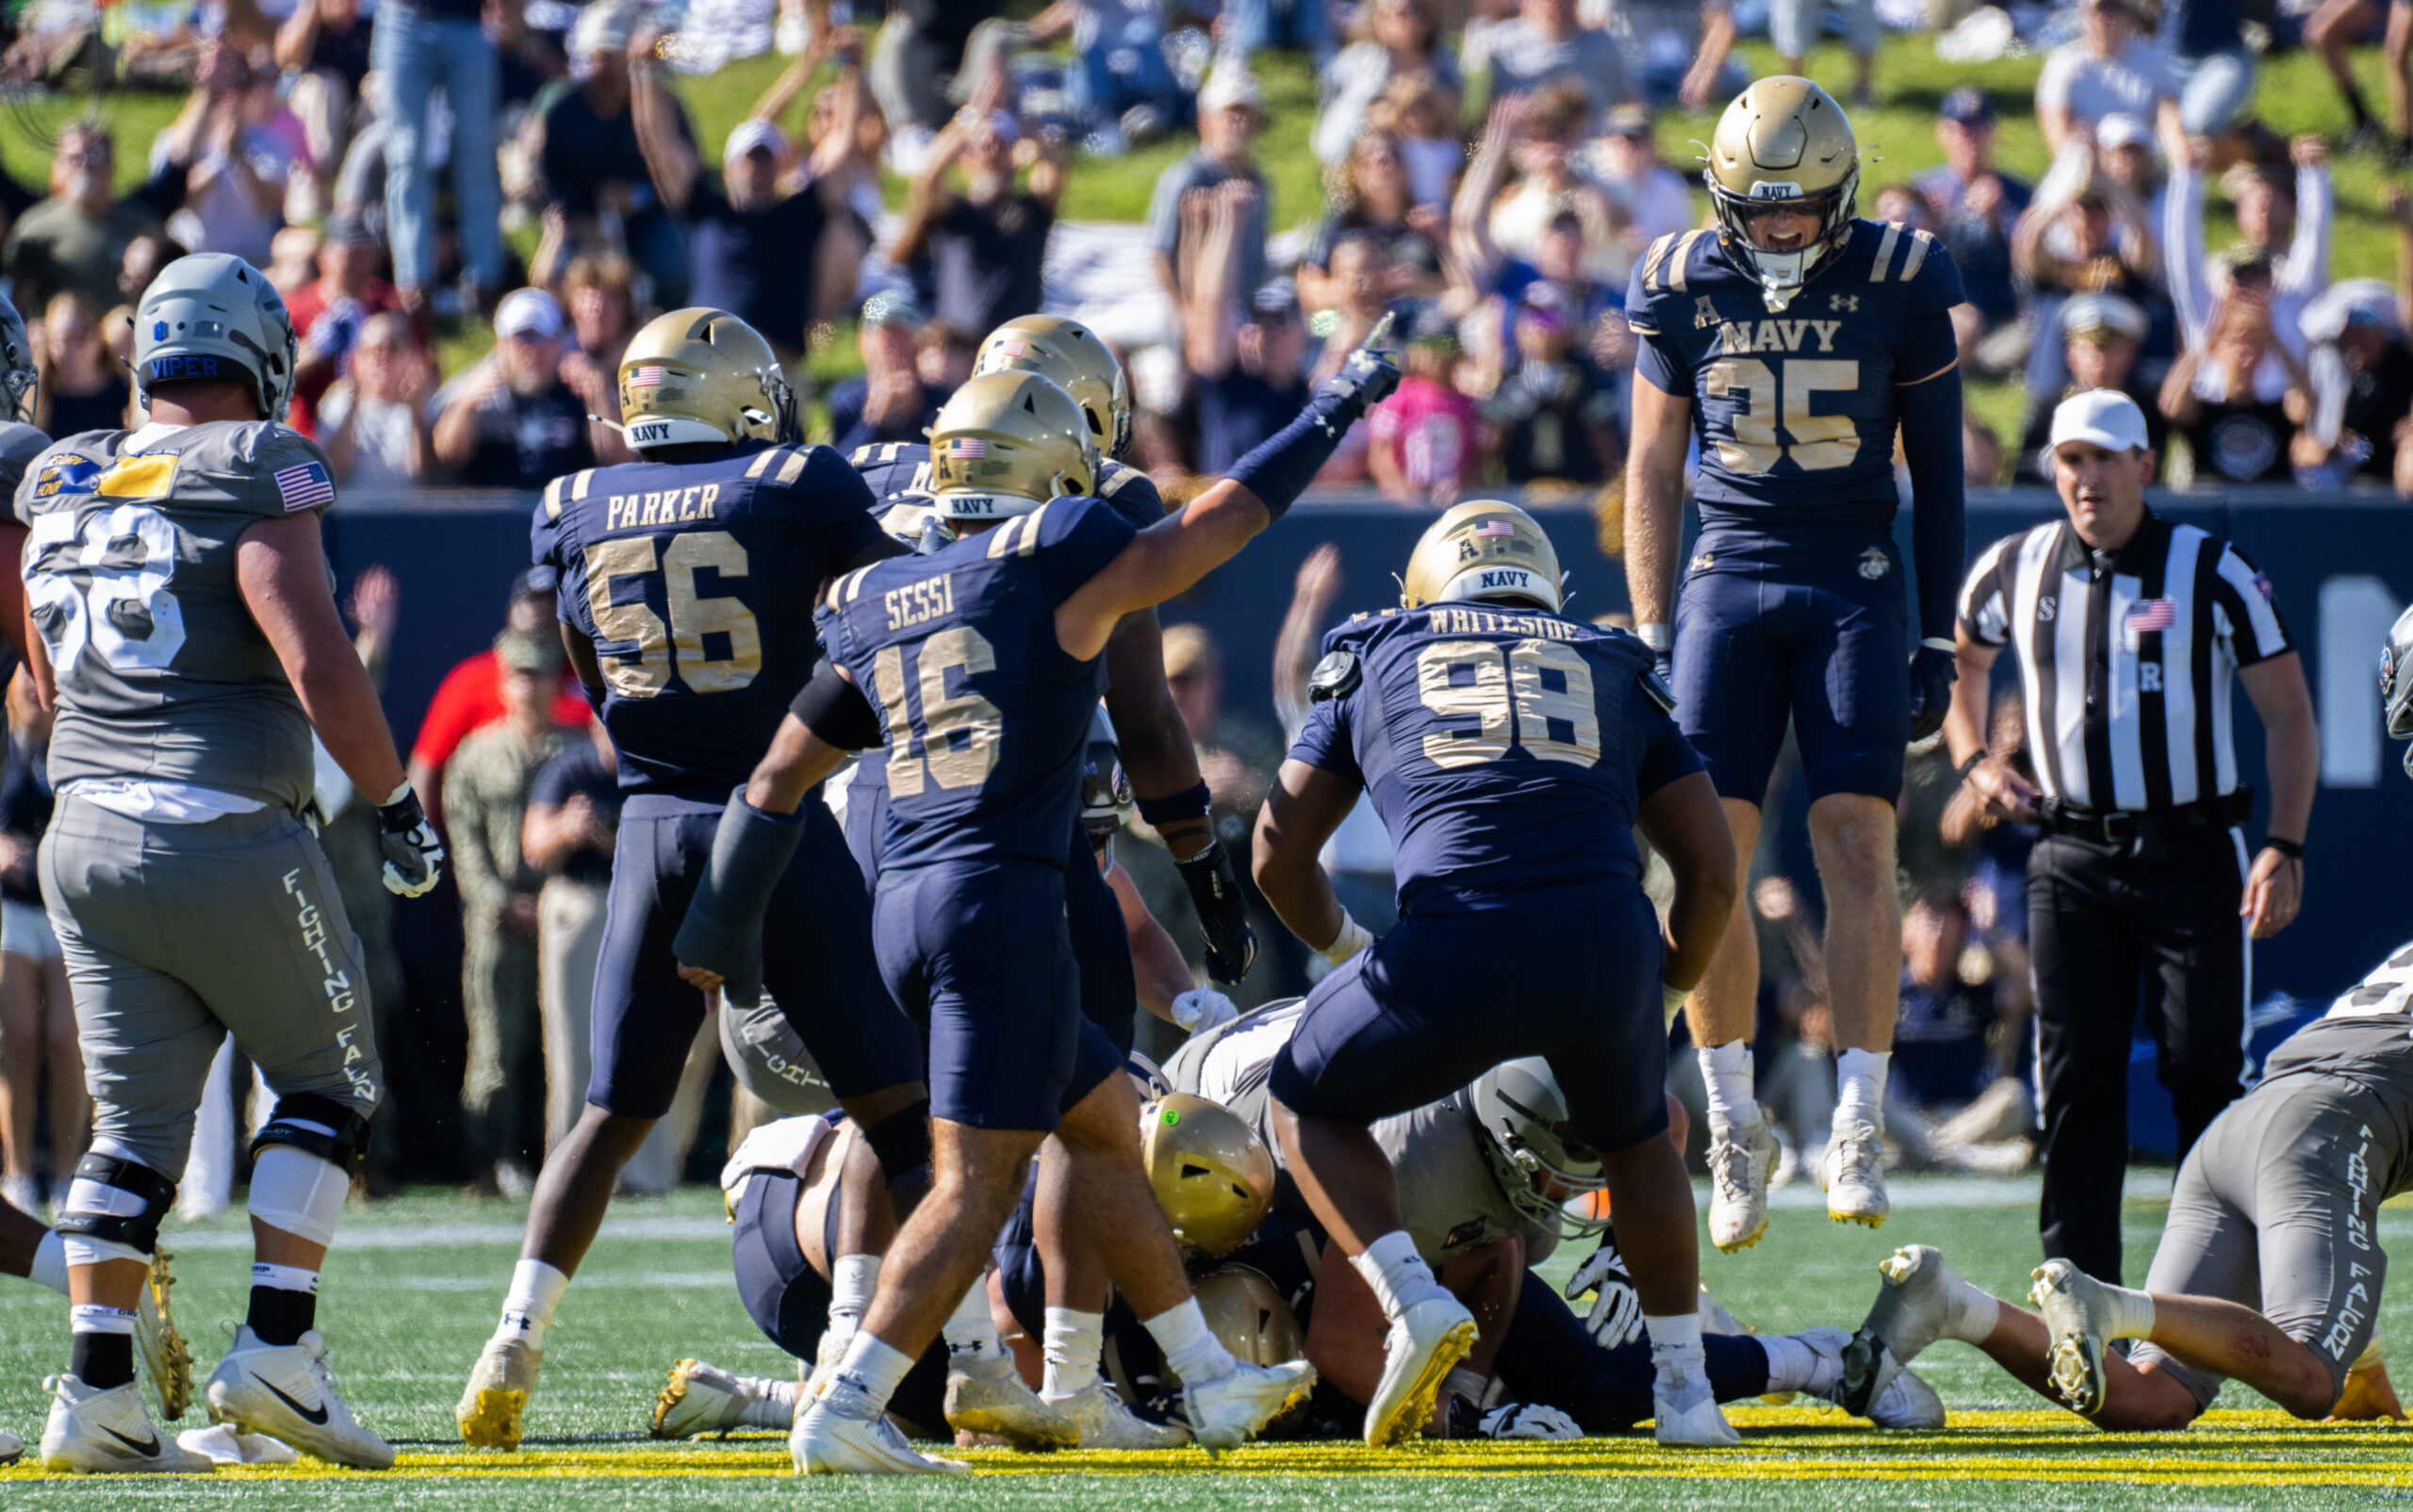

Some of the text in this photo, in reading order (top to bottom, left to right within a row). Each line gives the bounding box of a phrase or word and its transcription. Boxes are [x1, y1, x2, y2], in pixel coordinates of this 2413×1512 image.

[1762, 185, 1791, 198] NAVY
[1719, 320, 1842, 355] NAVY
[151, 356, 220, 379] VIPER
[1707, 357, 1862, 472] 35
[631, 423, 670, 443] NAVY
[606, 484, 720, 532] PARKER
[950, 498, 994, 514] NAVY
[21, 503, 187, 672] 58
[1481, 571, 1529, 588] NAVY
[583, 531, 762, 699] 56
[885, 573, 955, 632] SESSI
[2037, 596, 2056, 621] S
[1429, 608, 1581, 642] WHITESIDE
[2141, 661, 2162, 692] R
[875, 626, 1003, 799] 16
[1417, 638, 1600, 769] 98
[283, 867, 353, 1013] FIGHTING
